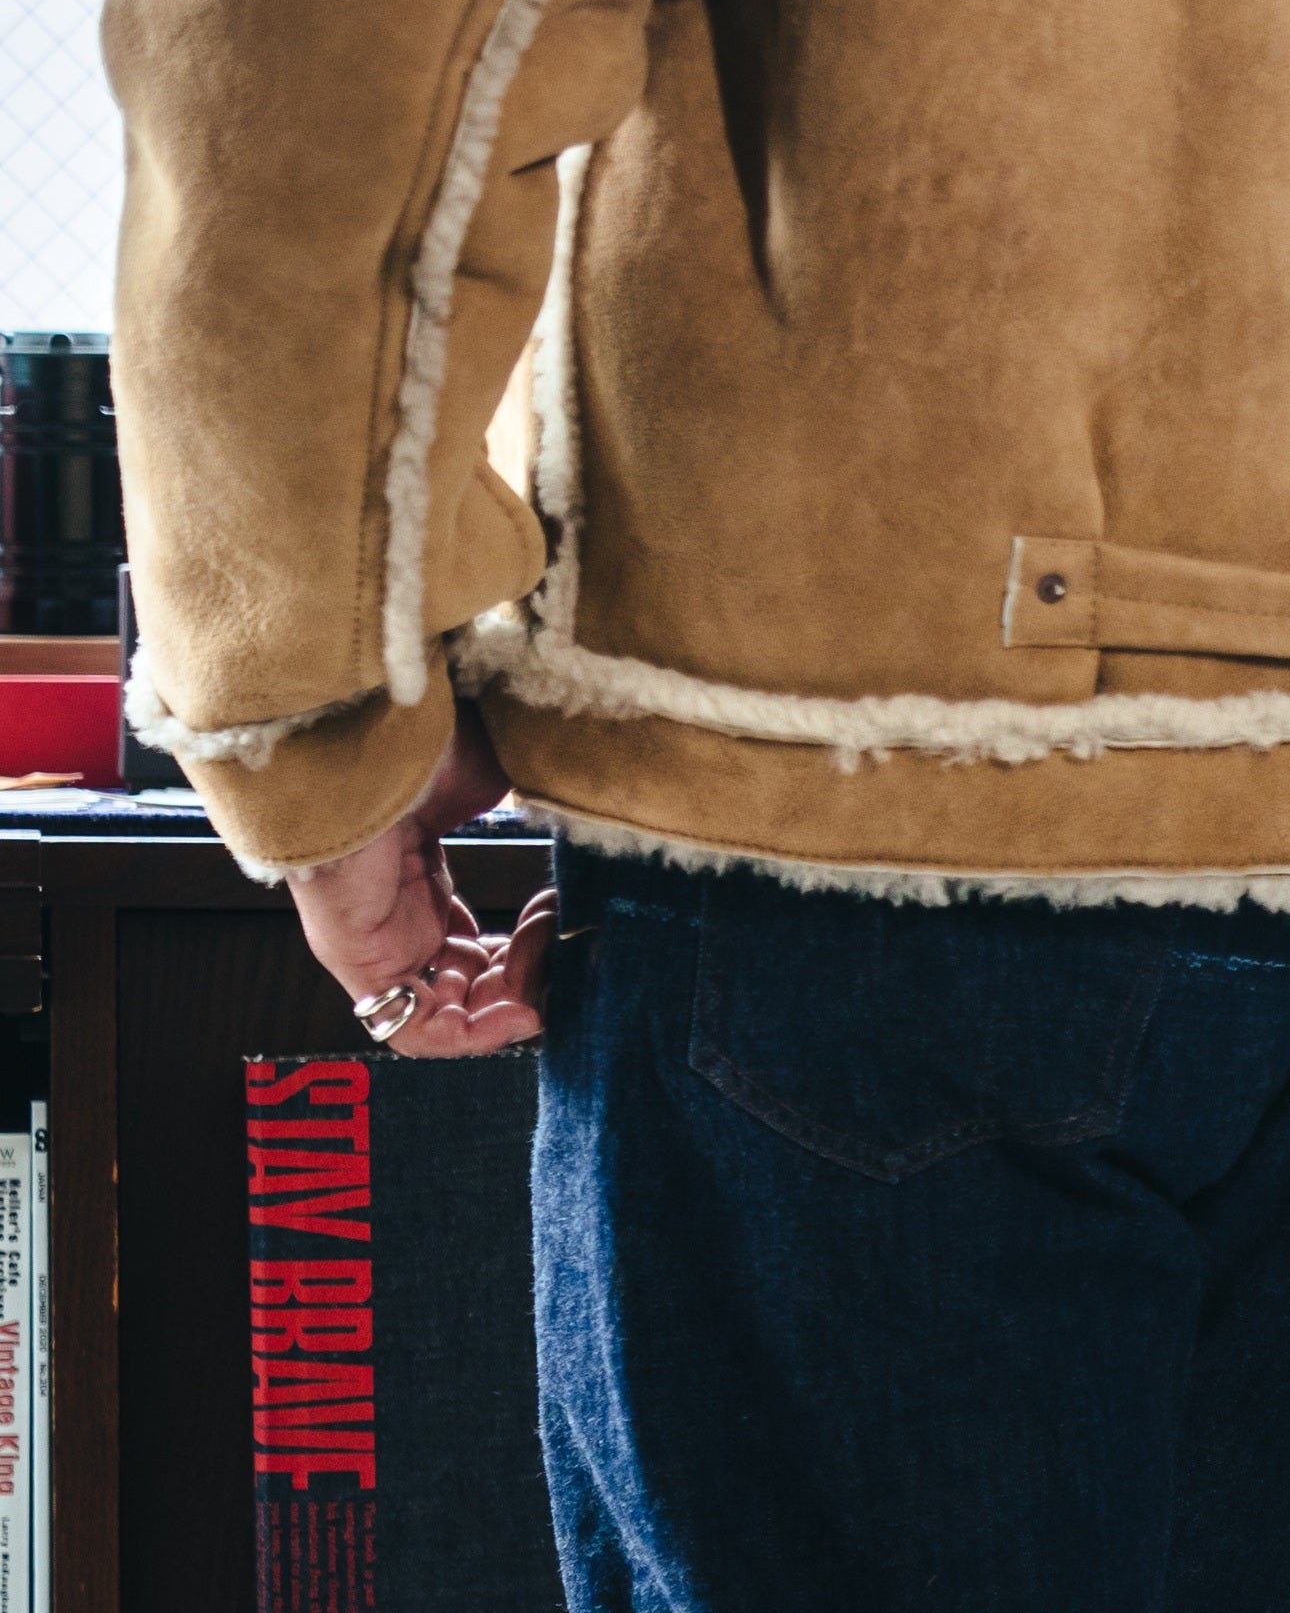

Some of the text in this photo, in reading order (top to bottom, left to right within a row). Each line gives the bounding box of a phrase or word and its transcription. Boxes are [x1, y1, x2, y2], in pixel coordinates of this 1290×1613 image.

[39, 1275, 47, 1325] DECEMBER
[245, 1061, 376, 1491] STAY BRAVE
